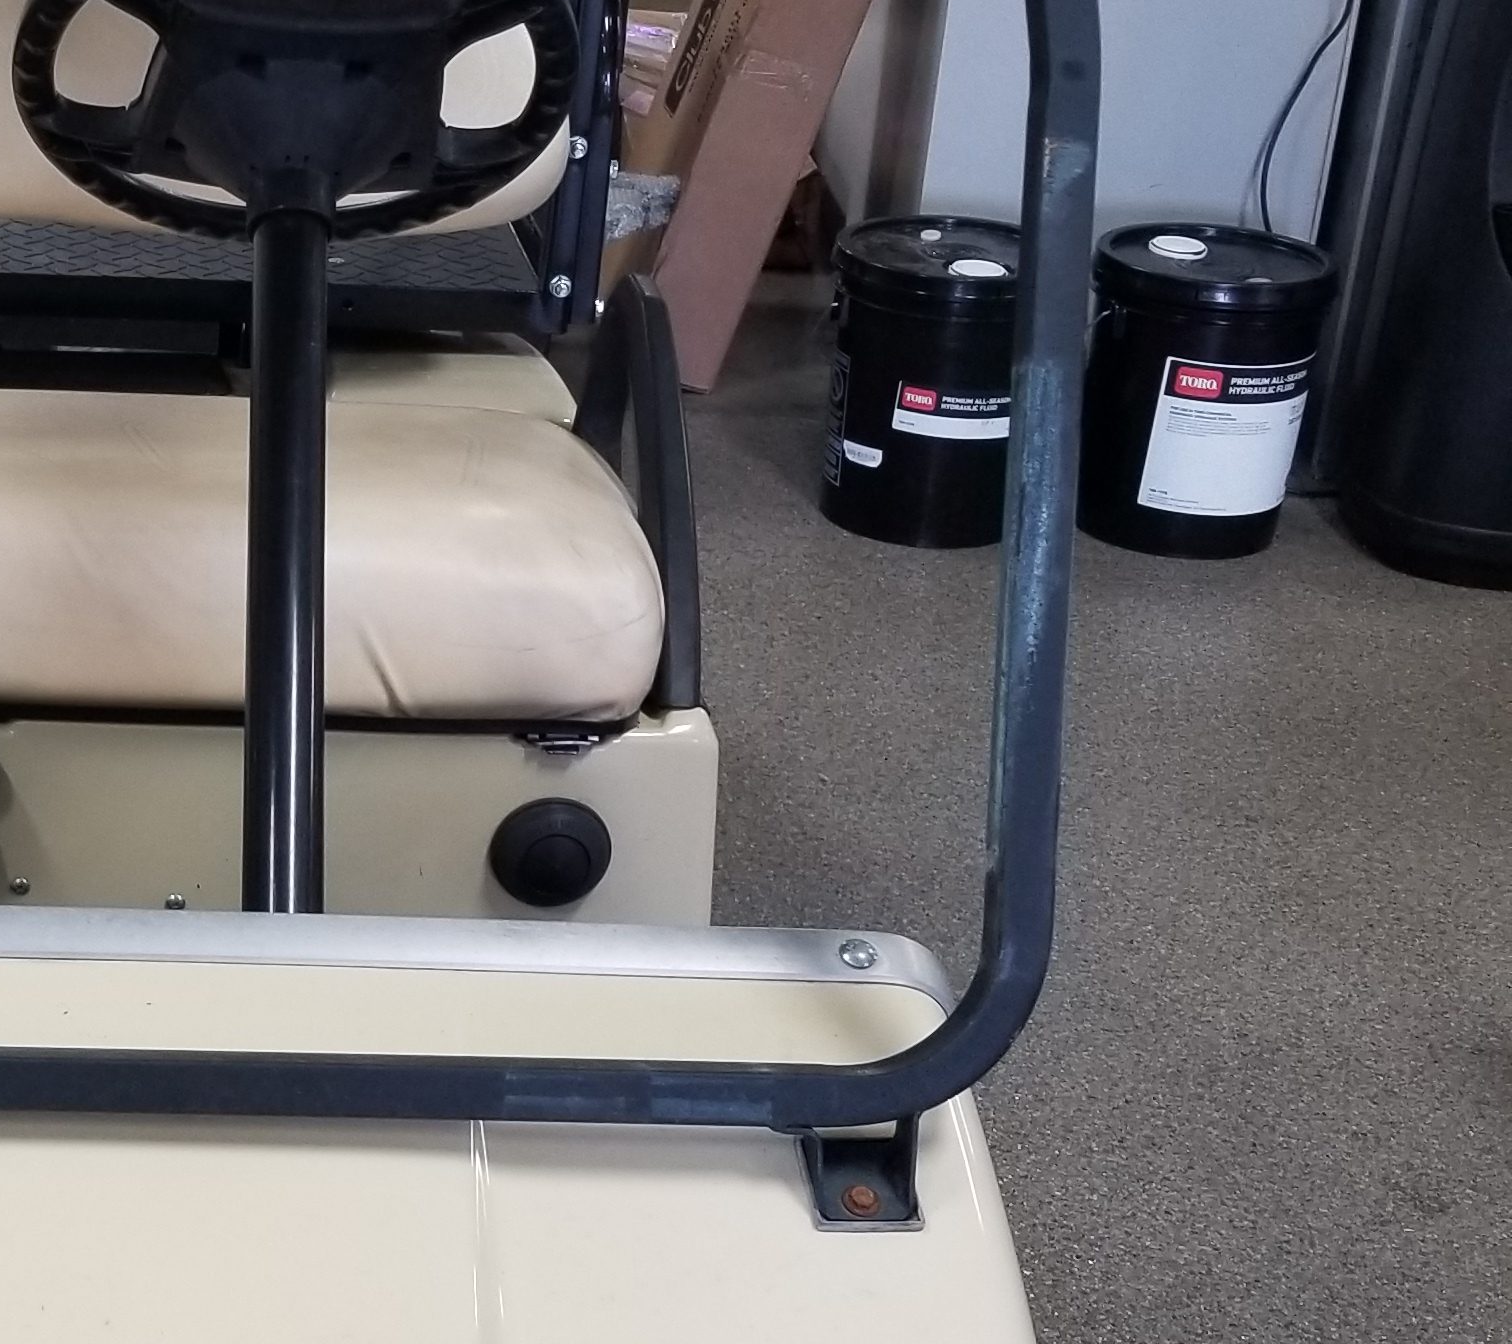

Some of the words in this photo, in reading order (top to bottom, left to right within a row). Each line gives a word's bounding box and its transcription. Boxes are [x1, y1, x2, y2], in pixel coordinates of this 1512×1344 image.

[675, 8, 712, 92] Club
[1179, 374, 1218, 390] TORO
[1230, 377, 1270, 385] PREMIUM
[1228, 386, 1276, 395] HYDRAULIC
[1276, 383, 1295, 393] FLUID
[905, 392, 933, 405] TORO
[942, 396, 974, 404] PREMIUM
[940, 403, 978, 412] HYDRAULIC
